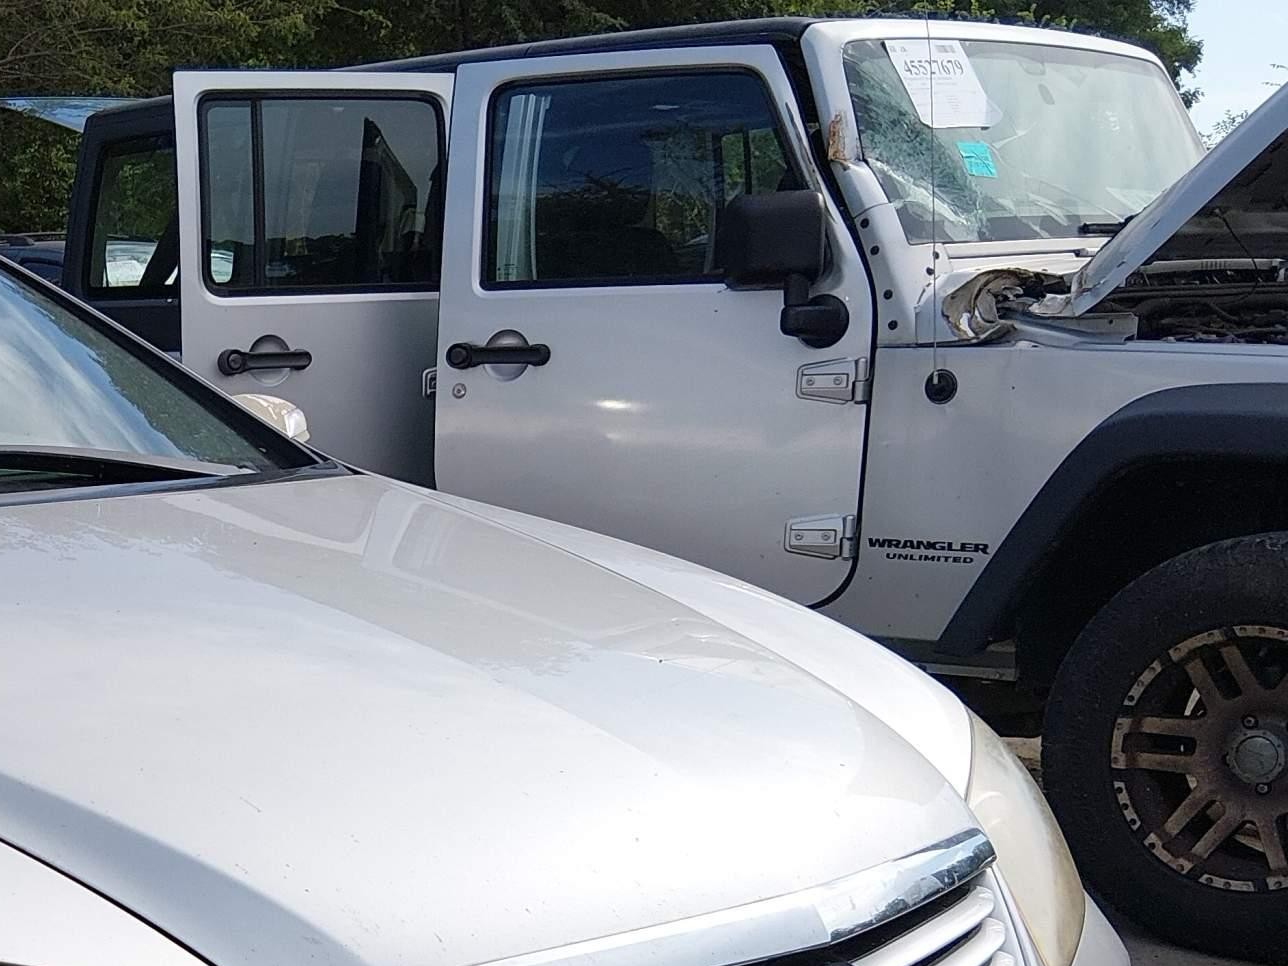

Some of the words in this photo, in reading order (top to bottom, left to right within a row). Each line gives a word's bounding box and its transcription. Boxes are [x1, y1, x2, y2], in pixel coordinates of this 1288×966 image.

[903, 59, 963, 75] 45527679
[868, 538, 989, 554] WRANGLER
[886, 553, 974, 564] UNLIMITED
